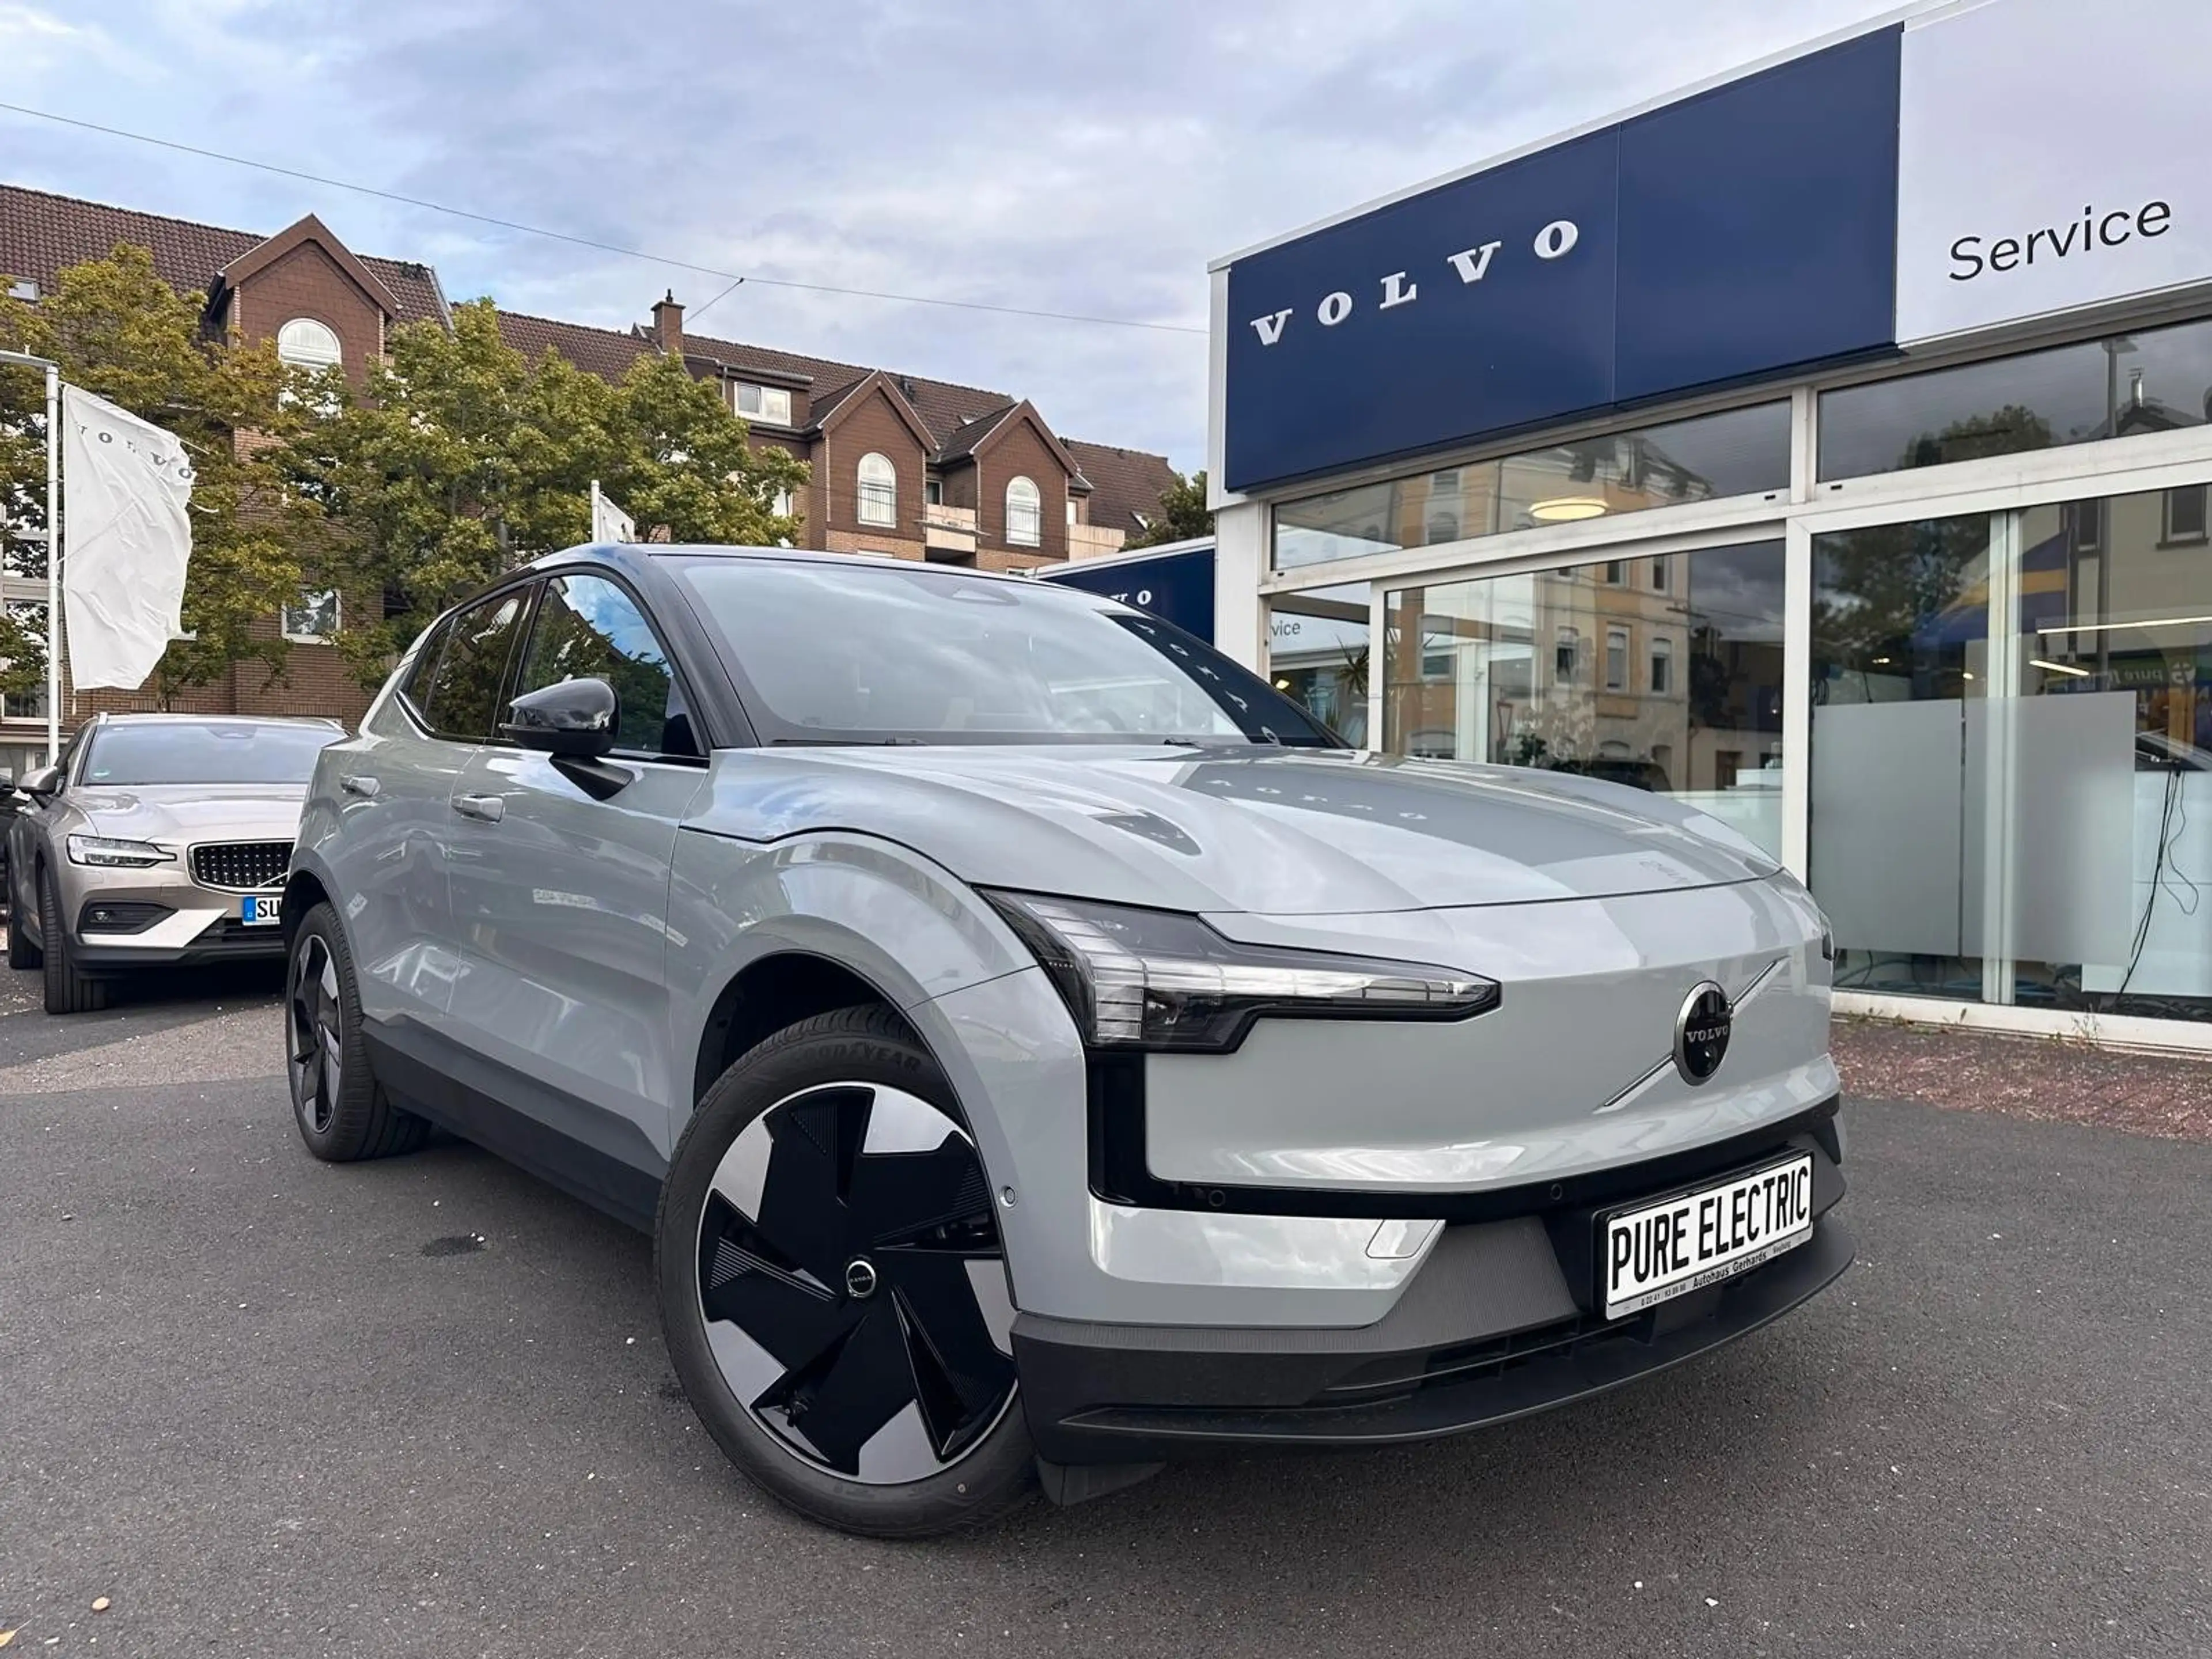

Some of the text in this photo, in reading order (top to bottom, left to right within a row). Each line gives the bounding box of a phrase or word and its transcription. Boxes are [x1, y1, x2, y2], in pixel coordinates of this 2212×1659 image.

[1949, 201, 2171, 281] Service
[1250, 220, 1578, 346] VOLVO
[1271, 620, 1301, 637] vice
[257, 900, 281, 918] SU
[1685, 1025, 1728, 1043] VOLVO
[1612, 1165, 1808, 1291] PURE ELECTRIC
[1692, 1267, 1729, 1289] Autohaus
[1732, 1251, 1767, 1272] Gerhards
